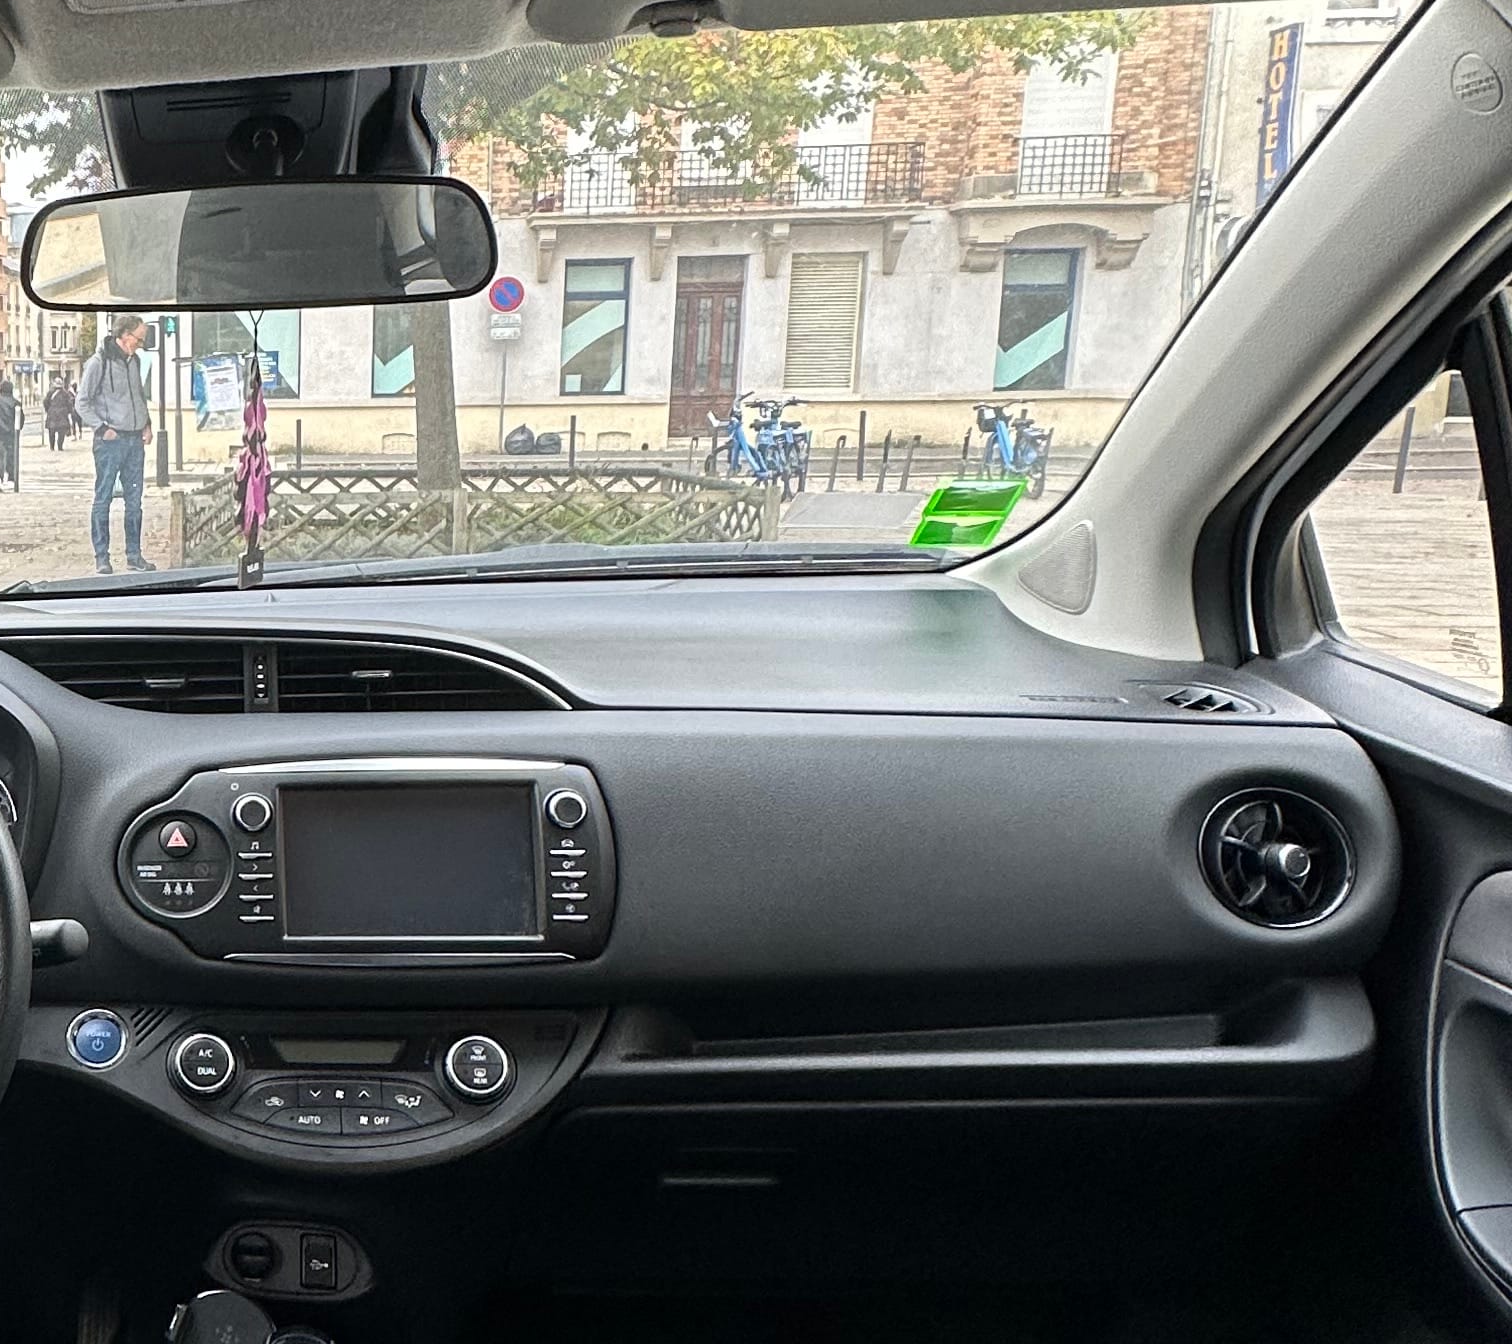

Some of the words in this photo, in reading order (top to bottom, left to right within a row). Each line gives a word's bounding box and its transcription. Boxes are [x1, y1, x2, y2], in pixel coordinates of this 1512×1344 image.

[1263, 29, 1291, 180] HOTEL
[198, 1048, 213, 1058] A/C
[197, 1066, 217, 1076] DUAL
[297, 1115, 322, 1124] AUTO
[373, 1116, 390, 1125] OFF
